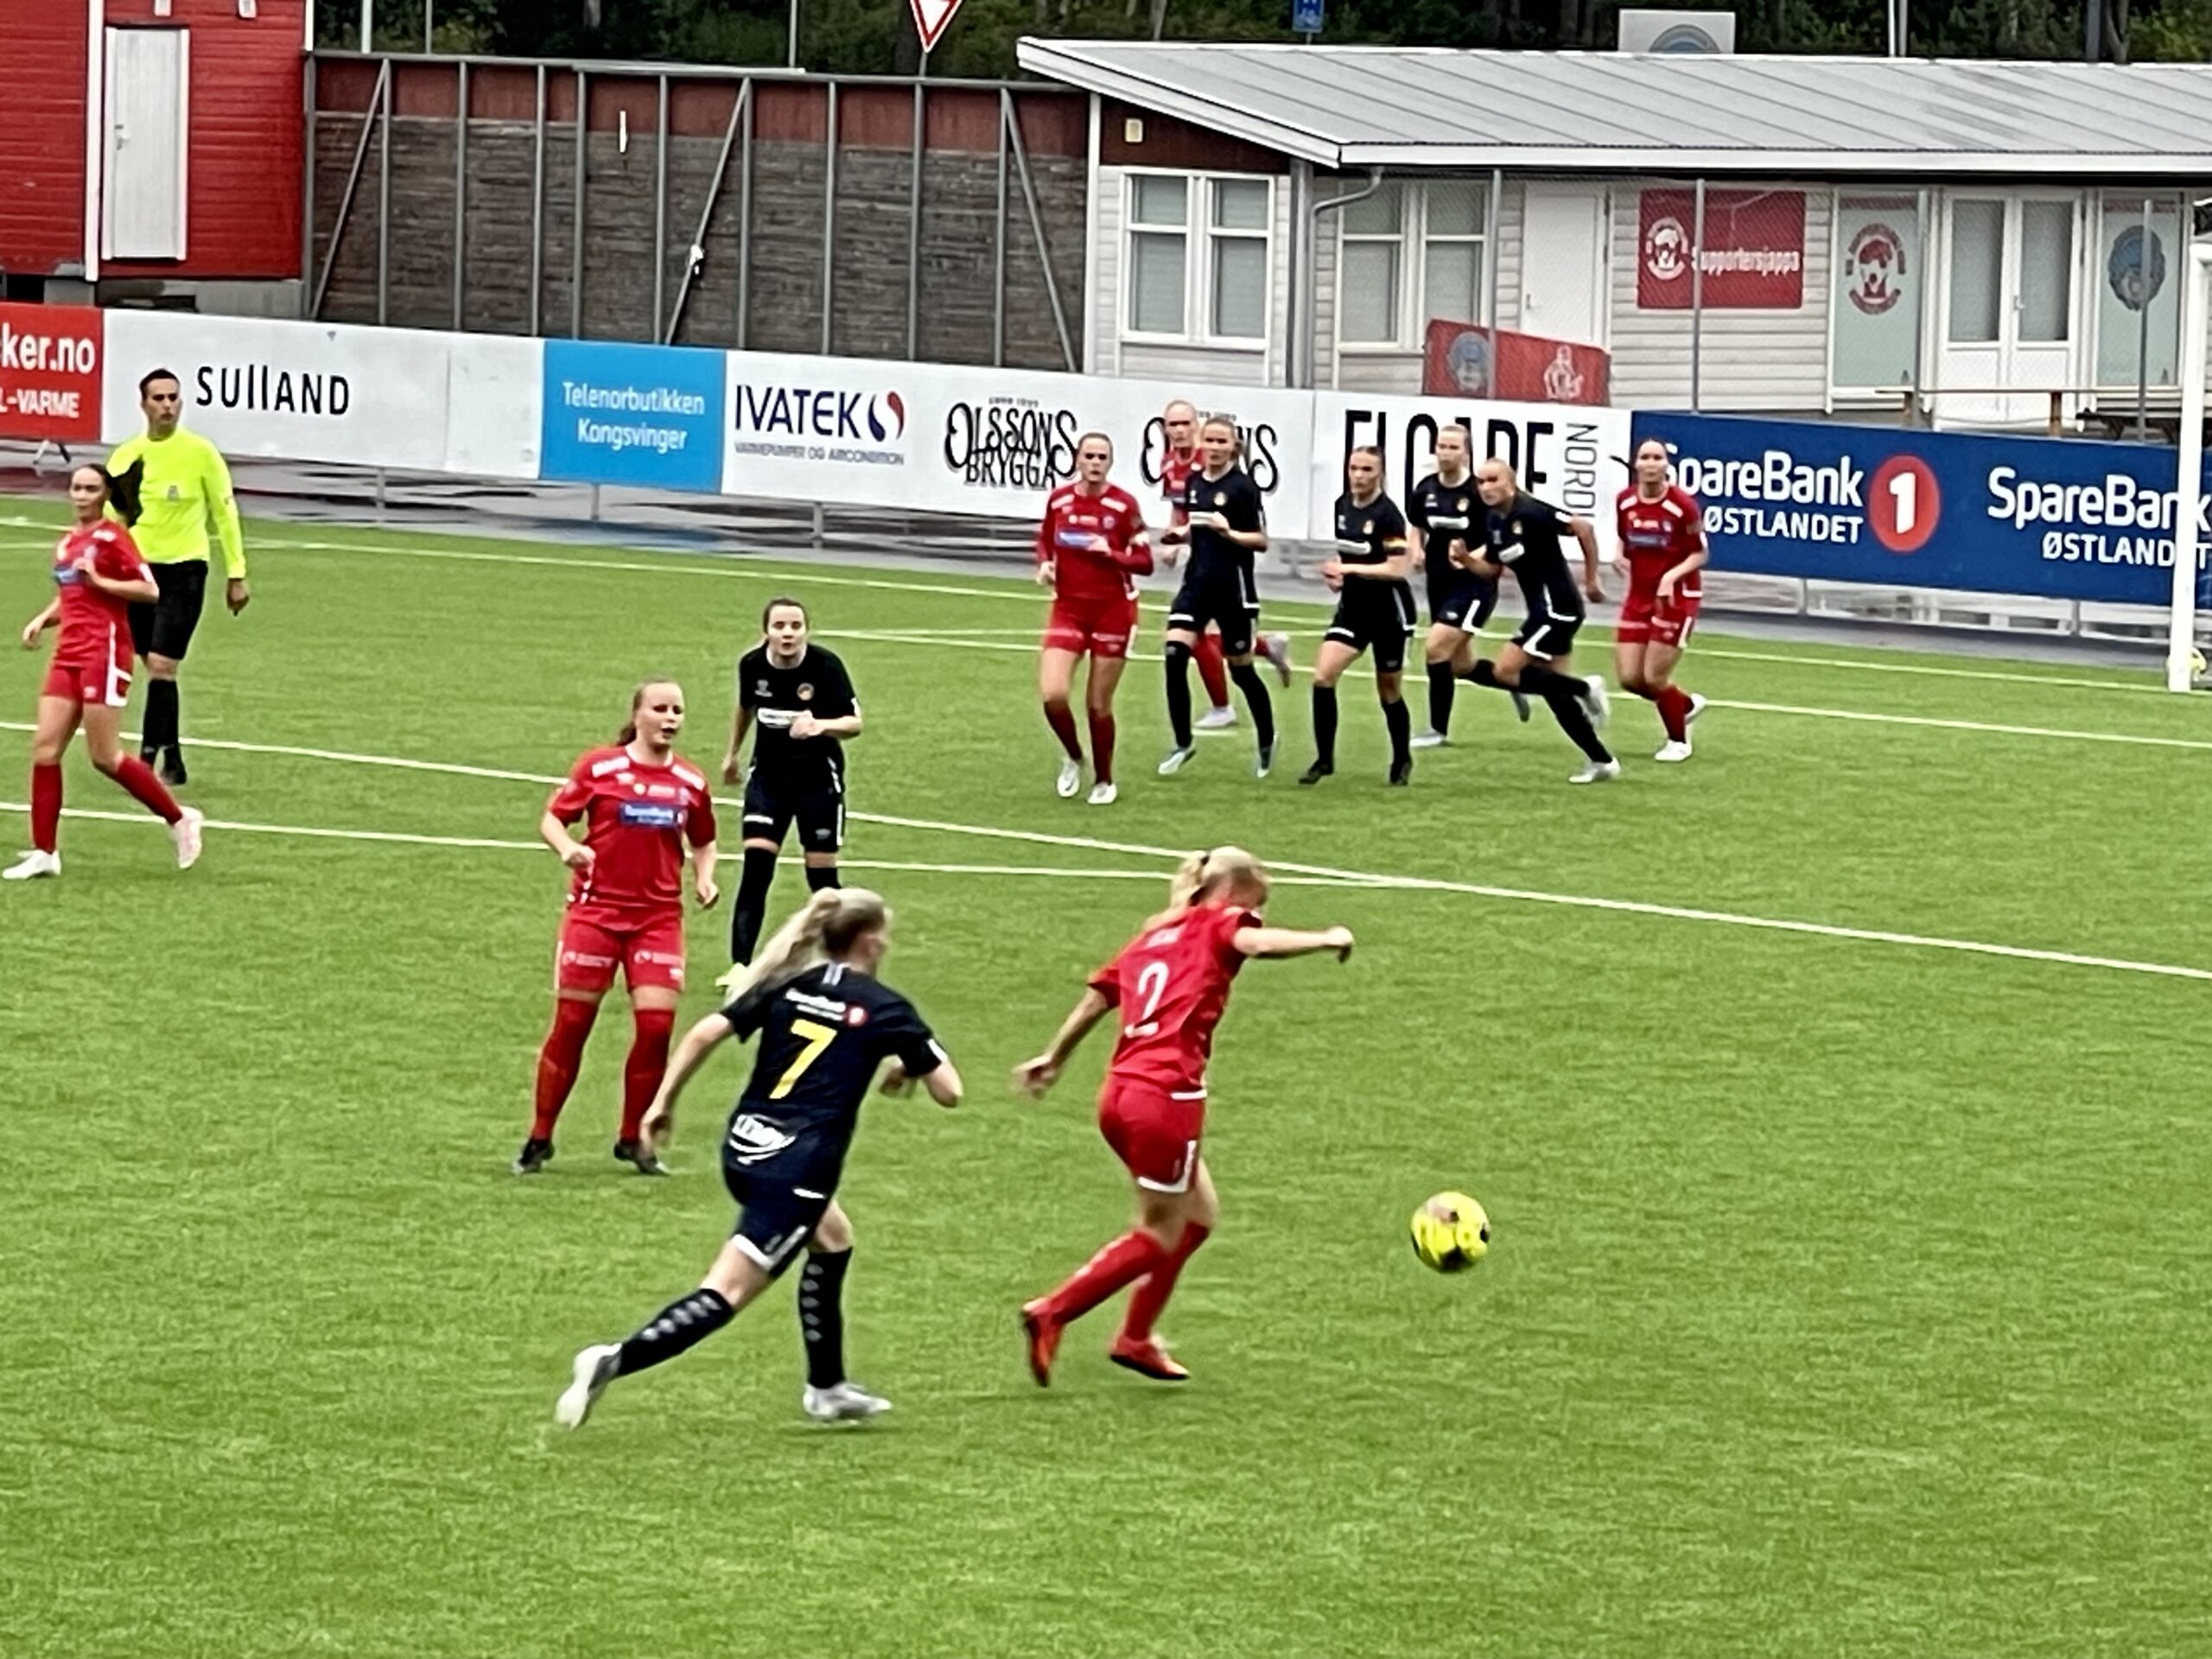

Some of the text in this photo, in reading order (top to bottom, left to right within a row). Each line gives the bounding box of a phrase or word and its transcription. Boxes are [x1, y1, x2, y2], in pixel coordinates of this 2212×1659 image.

[1, 321, 96, 375] ker.no
[562, 381, 705, 416] Telenorbutikken
[735, 385, 863, 441] IVATEK
[577, 417, 689, 455] Kongsvinger
[944, 401, 1077, 477] OLSSONS
[964, 447, 1057, 491] BRYGGA
[1703, 505, 1863, 544] ØSTLANDET
[1890, 473, 1917, 534] 1
[2042, 531, 2212, 570] ØSTLANDT
[1124, 961, 1169, 1039] 2
[768, 1018, 838, 1100] 7
